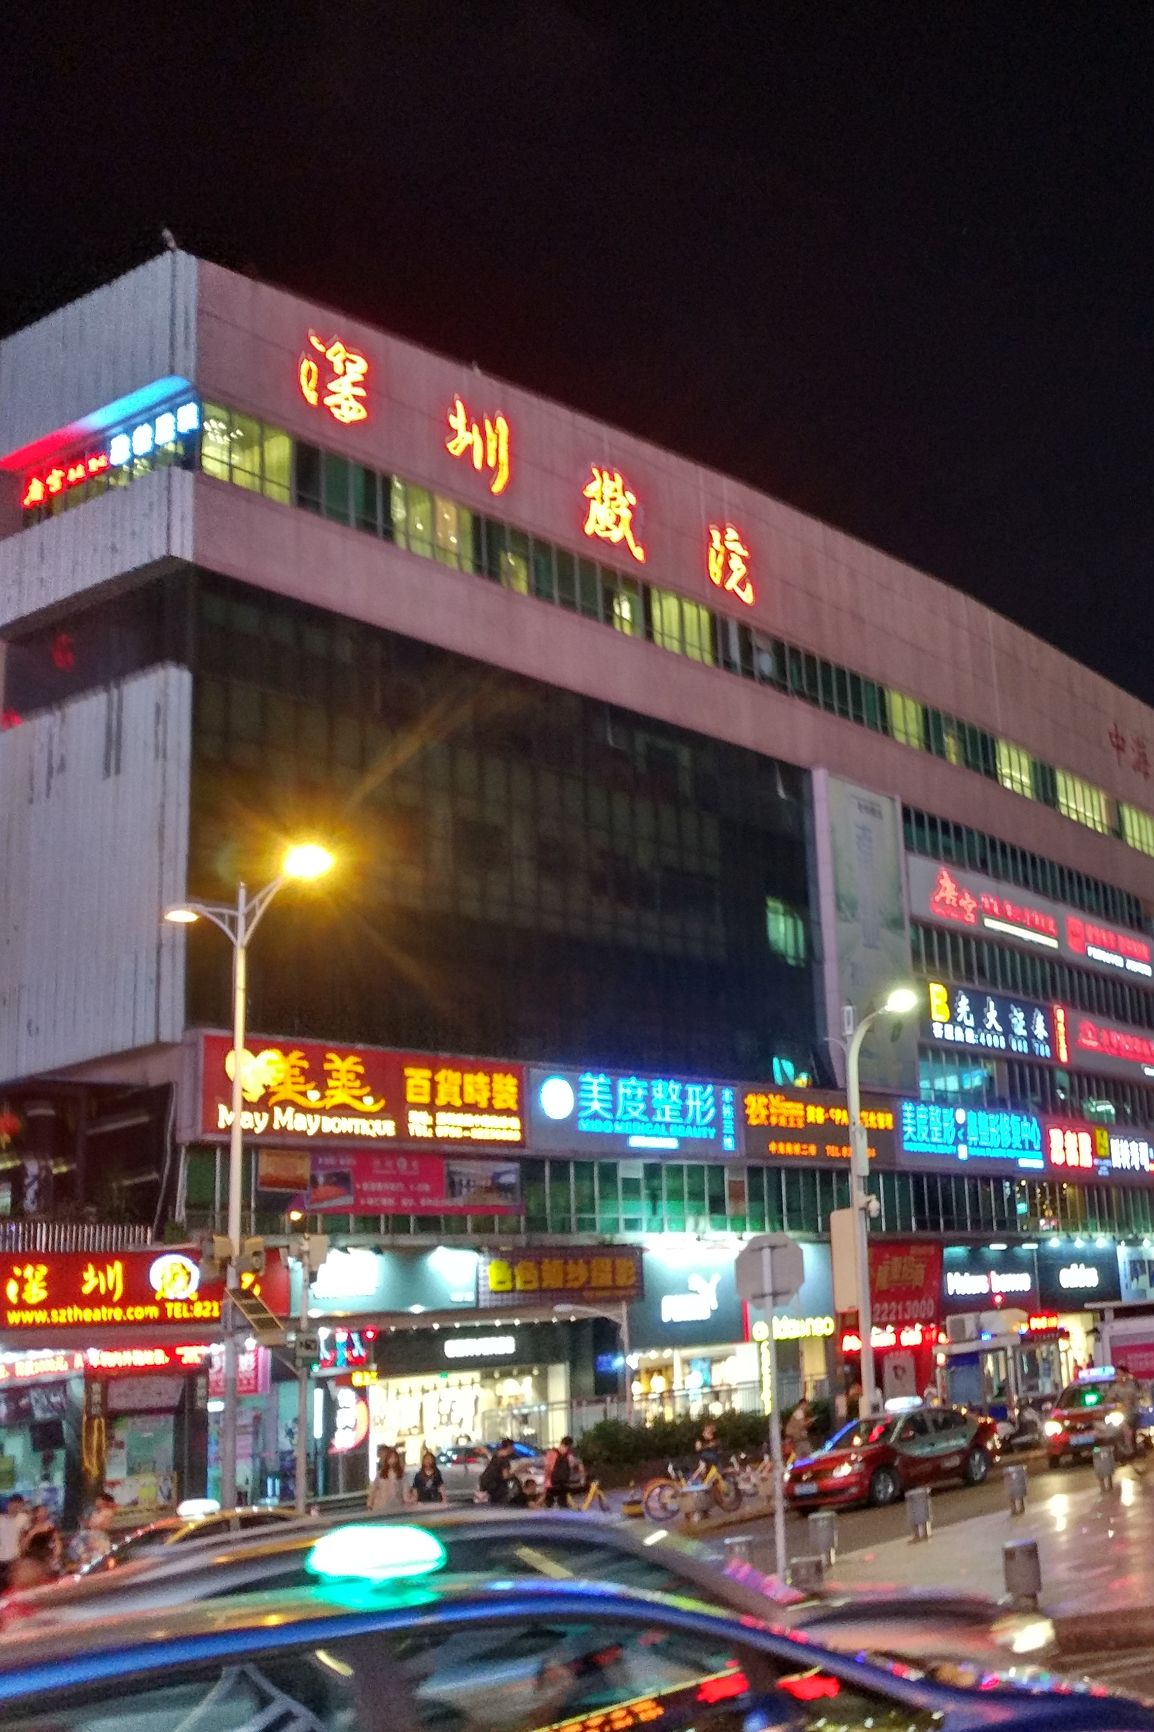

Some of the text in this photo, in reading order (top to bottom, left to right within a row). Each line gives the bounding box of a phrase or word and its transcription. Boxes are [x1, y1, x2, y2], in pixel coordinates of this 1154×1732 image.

[578, 1072, 717, 1127] 美度整形
[217, 1103, 269, 1134] May
[273, 1105, 321, 1136] May
[7, 1303, 160, 1325] www.sztheatre.com
